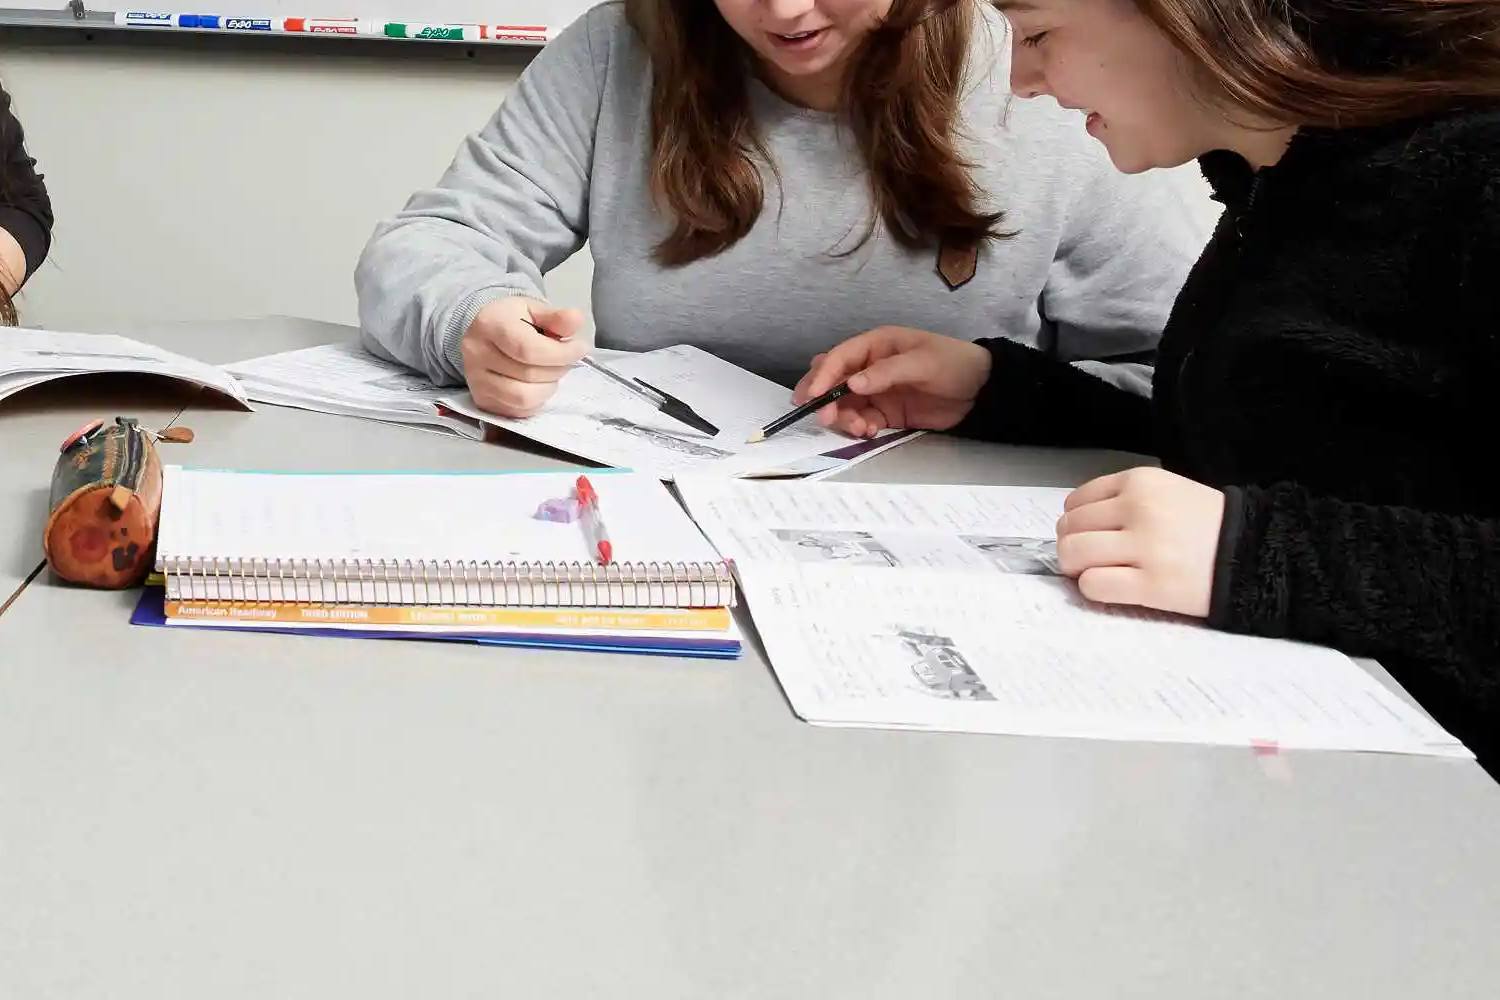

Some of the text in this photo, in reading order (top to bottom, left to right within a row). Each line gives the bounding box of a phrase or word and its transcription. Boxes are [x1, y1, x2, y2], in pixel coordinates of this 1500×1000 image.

[228, 20, 251, 29] EXPO
[420, 27, 450, 38] EXPO
[178, 606, 227, 617] American
